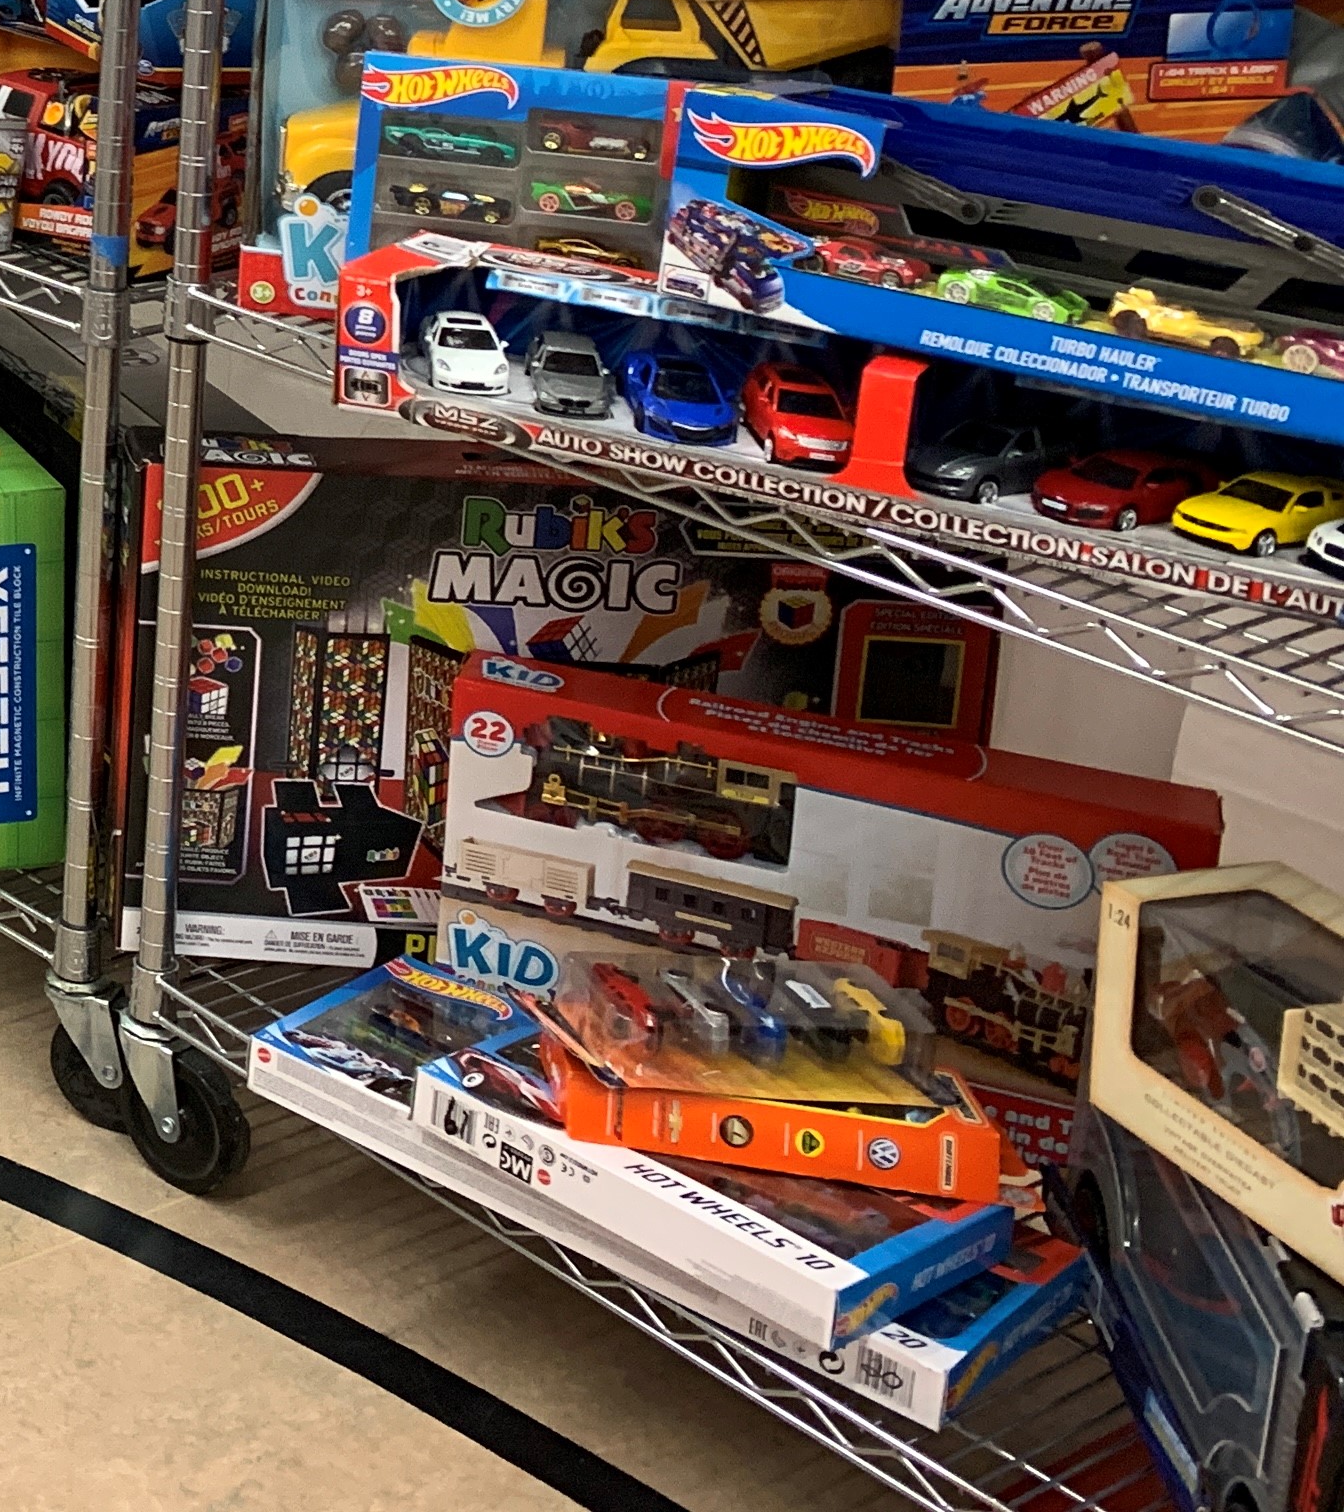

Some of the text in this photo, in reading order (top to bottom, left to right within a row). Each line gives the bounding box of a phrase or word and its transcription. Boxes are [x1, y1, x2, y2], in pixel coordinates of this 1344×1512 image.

[1001, 13, 1116, 32] FORCE
[387, 65, 514, 103] HOT WHEELS
[1025, 66, 1100, 118] WARNING
[733, 122, 868, 165] HOT WHEELS
[1051, 335, 1158, 373] TURBO HAULER
[919, 329, 1291, 423] REMOLQUE COLECCIONADOR TRANSPORTEUR TURBO
[462, 495, 659, 556] Rubik's
[536, 426, 602, 457] AUTO
[608, 443, 688, 474] SHOW
[1091, 545, 1198, 587] SALON
[1208, 571, 1249, 597] DE
[200, 568, 352, 587] INSTRUCTIONAL VIDEO
[237, 582, 312, 597] DOWNLOAD!
[428, 551, 683, 614] MAGIC
[197, 591, 347, 610] VIDÉO D'ENSEIGNEMENT
[232, 603, 321, 621] TÉLÉCHARGER
[13, 565, 23, 757] MAGNETIC CONSTRUCTION BLOCK
[483, 660, 563, 690] KID
[469, 722, 508, 743] 22
[1106, 903, 1132, 929] 1:24
[452, 927, 557, 988] KID
[623, 1161, 835, 1273] HOT WHEELS 10
[878, 1323, 930, 1352] 20
